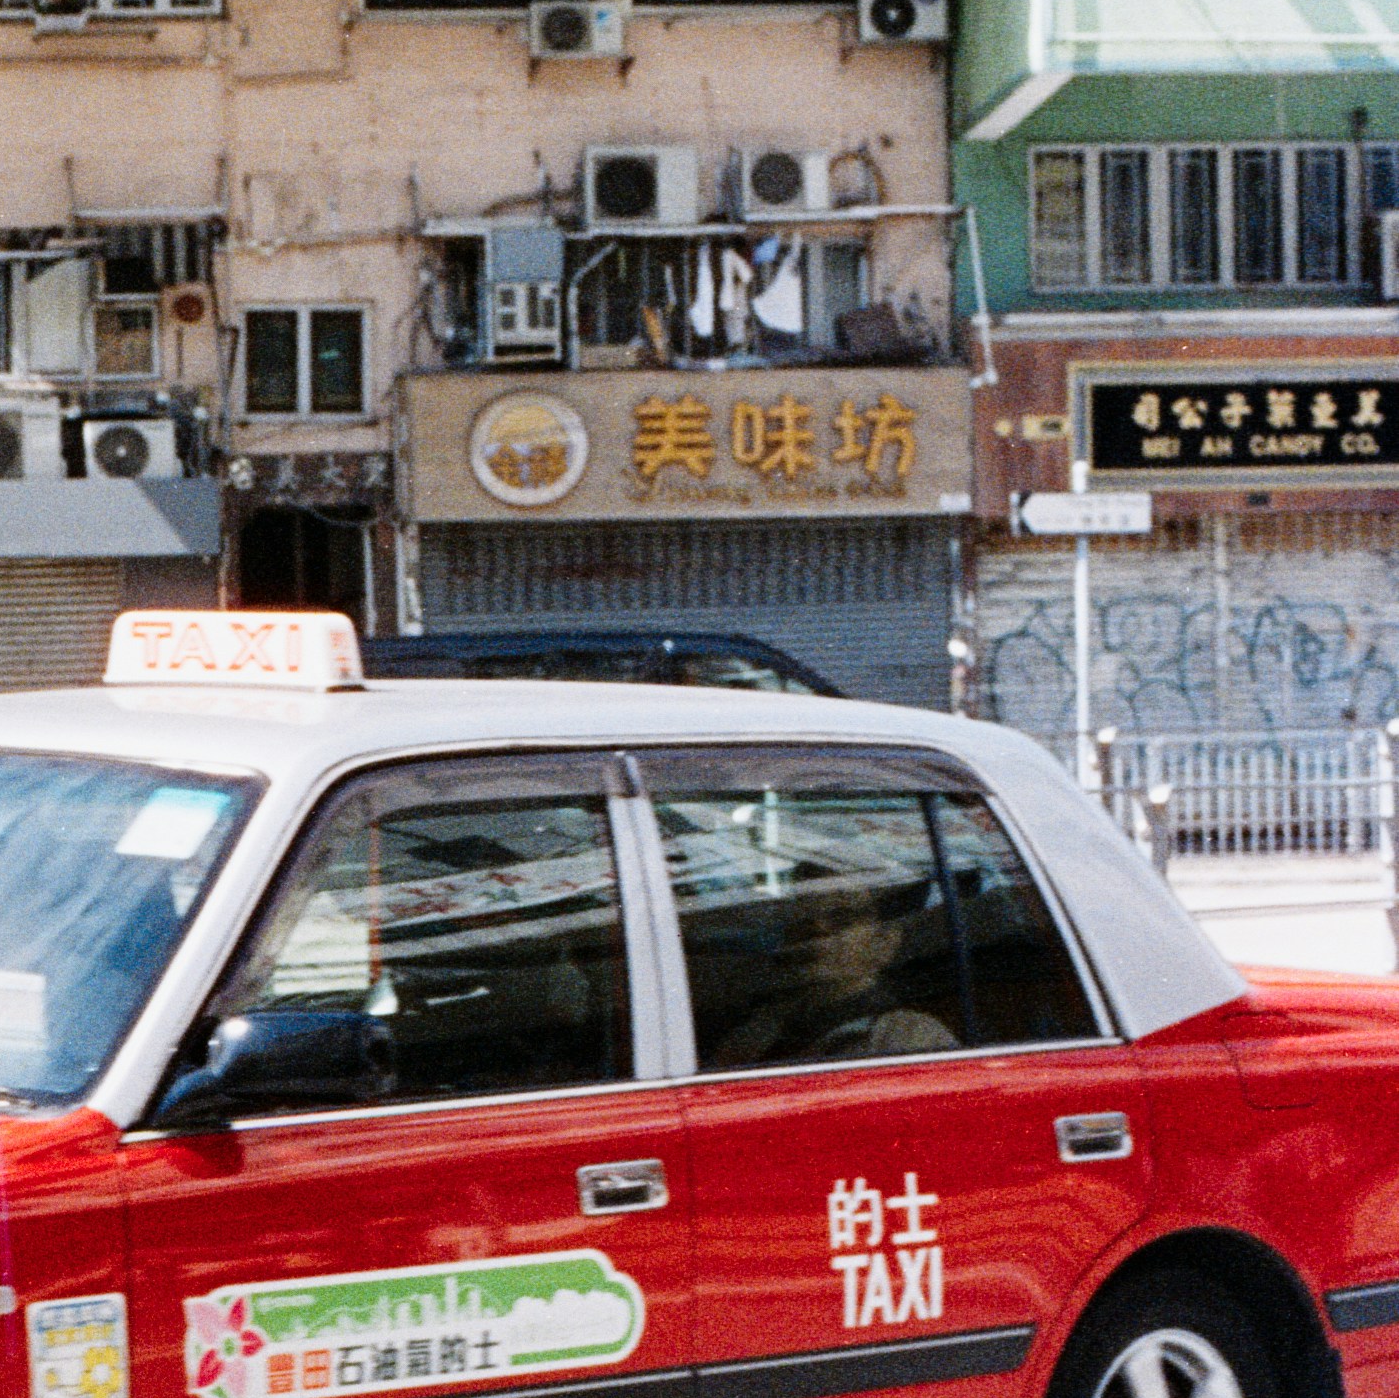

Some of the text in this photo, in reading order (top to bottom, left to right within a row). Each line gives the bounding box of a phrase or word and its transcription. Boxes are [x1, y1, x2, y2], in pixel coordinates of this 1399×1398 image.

[632, 393, 916, 478] 美味坊
[1249, 434, 1325, 458] CANDY
[132, 620, 299, 672] TAXI
[827, 1171, 940, 1249] 的士
[831, 1245, 943, 1328] TAXI
